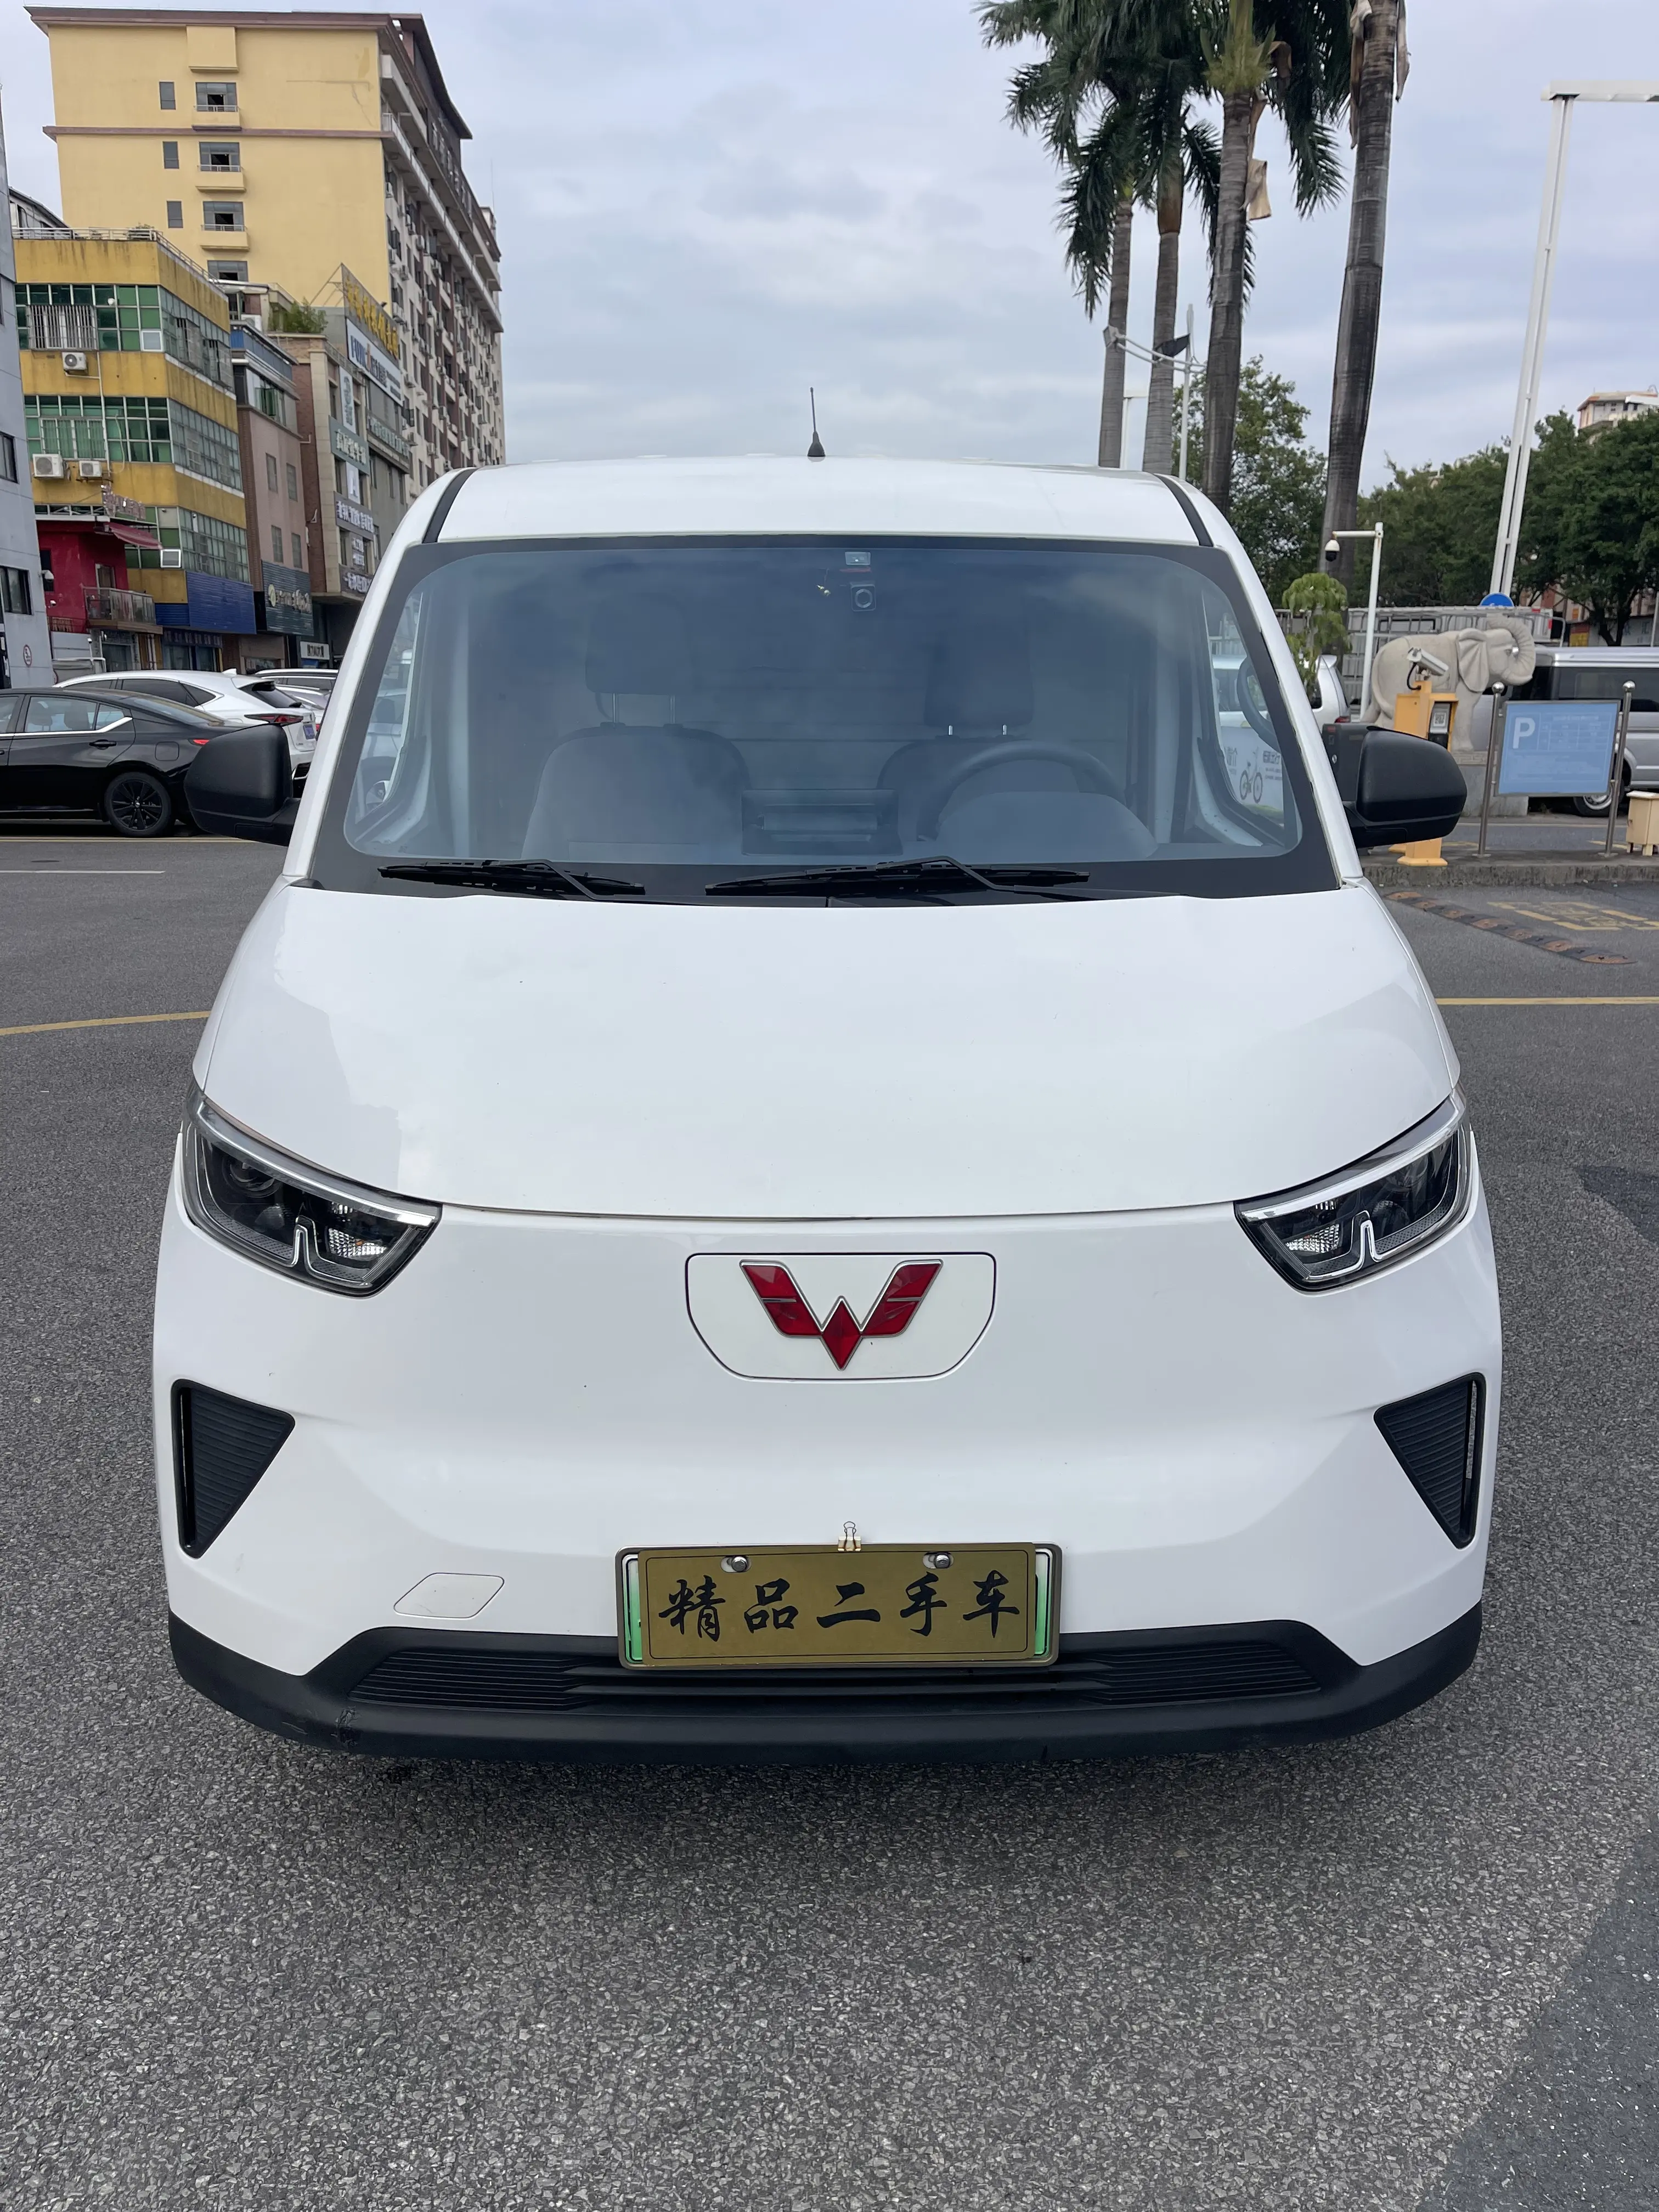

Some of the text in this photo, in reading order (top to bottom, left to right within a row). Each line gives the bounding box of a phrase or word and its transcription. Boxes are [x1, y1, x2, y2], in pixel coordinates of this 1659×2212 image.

[1513, 718, 1536, 749] P
[659, 1570, 1020, 1642] 精品二手车
